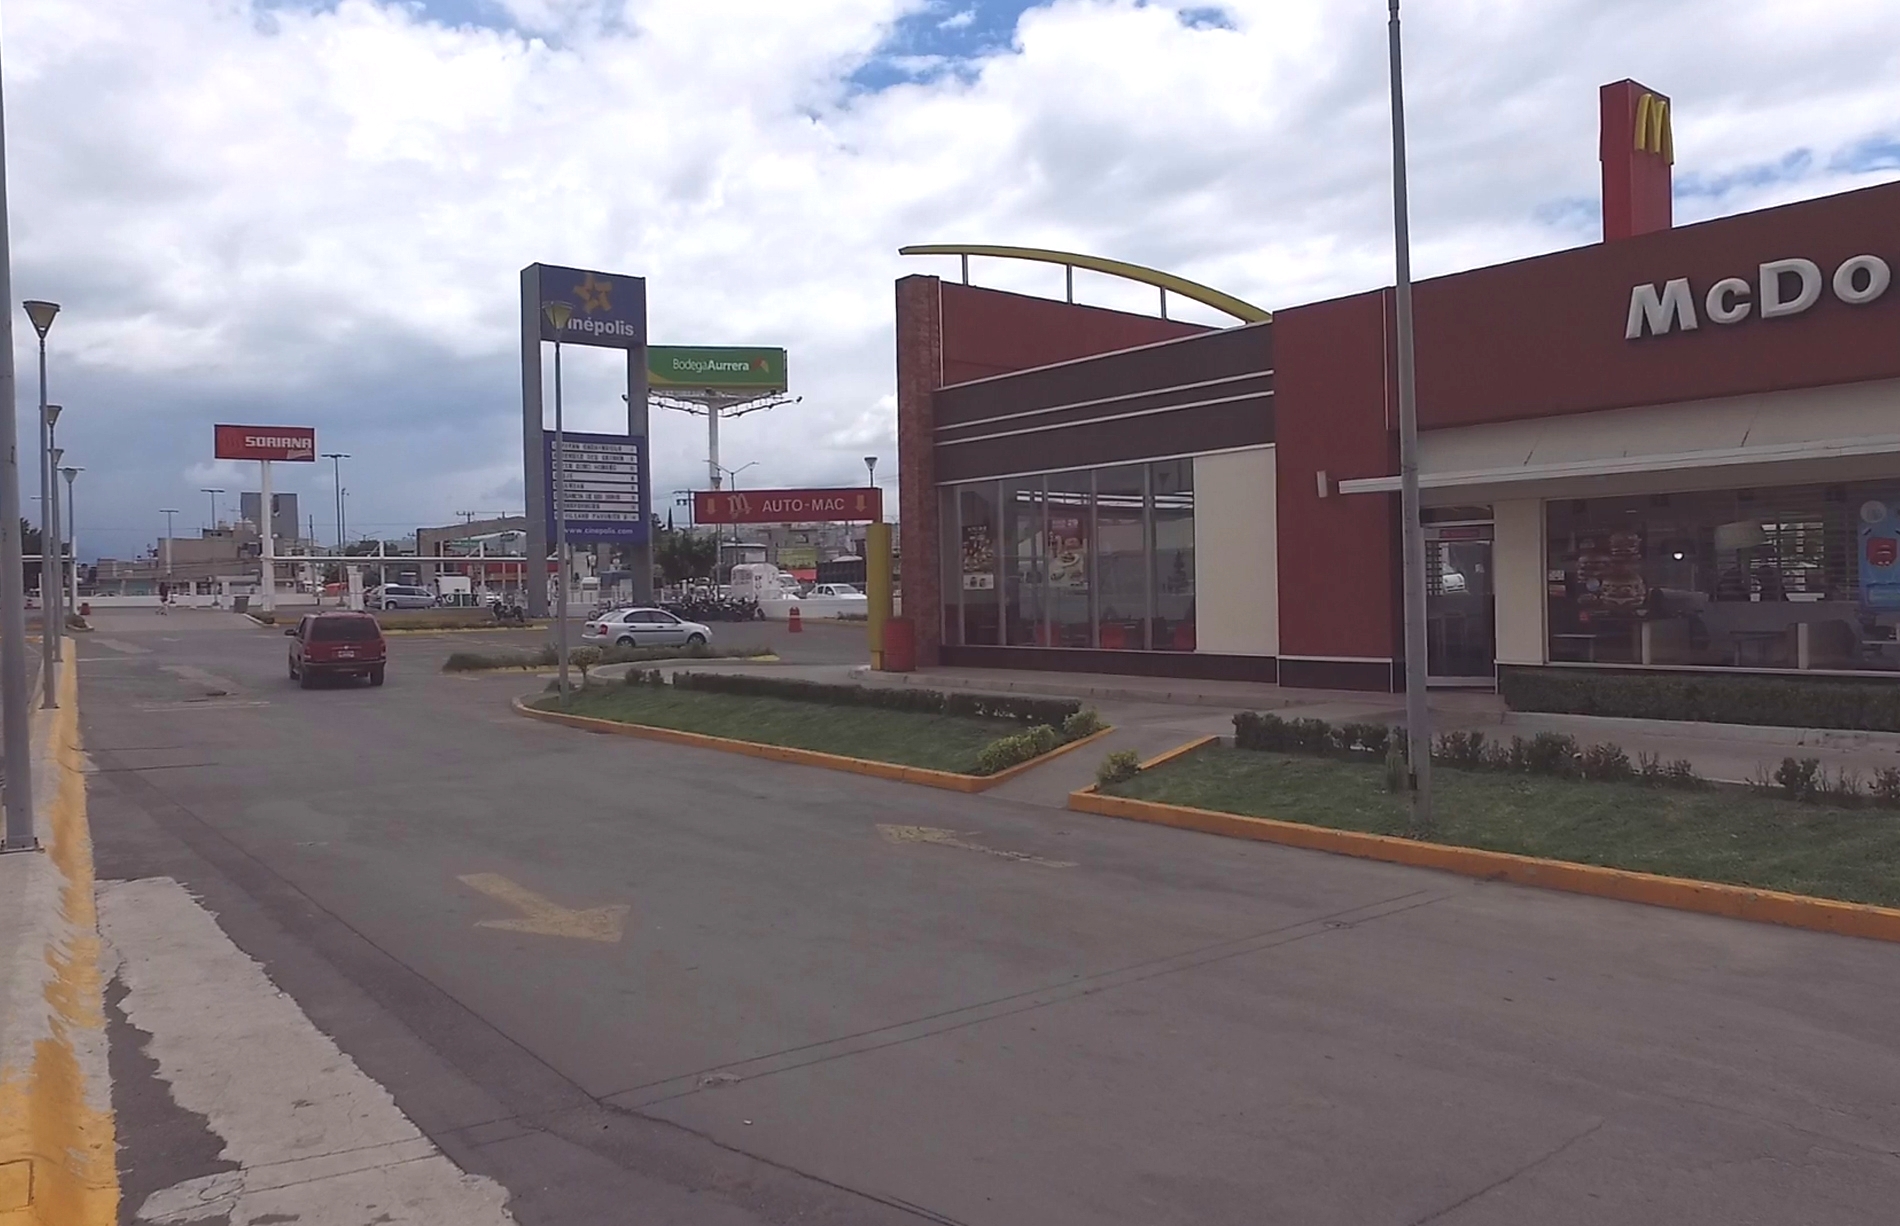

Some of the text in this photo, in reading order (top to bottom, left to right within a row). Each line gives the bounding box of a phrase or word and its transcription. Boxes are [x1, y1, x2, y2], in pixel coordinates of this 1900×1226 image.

[567, 316, 635, 336] inépolis
[245, 436, 312, 449] SORIANA
[762, 498, 845, 513] AUTO-MAC
